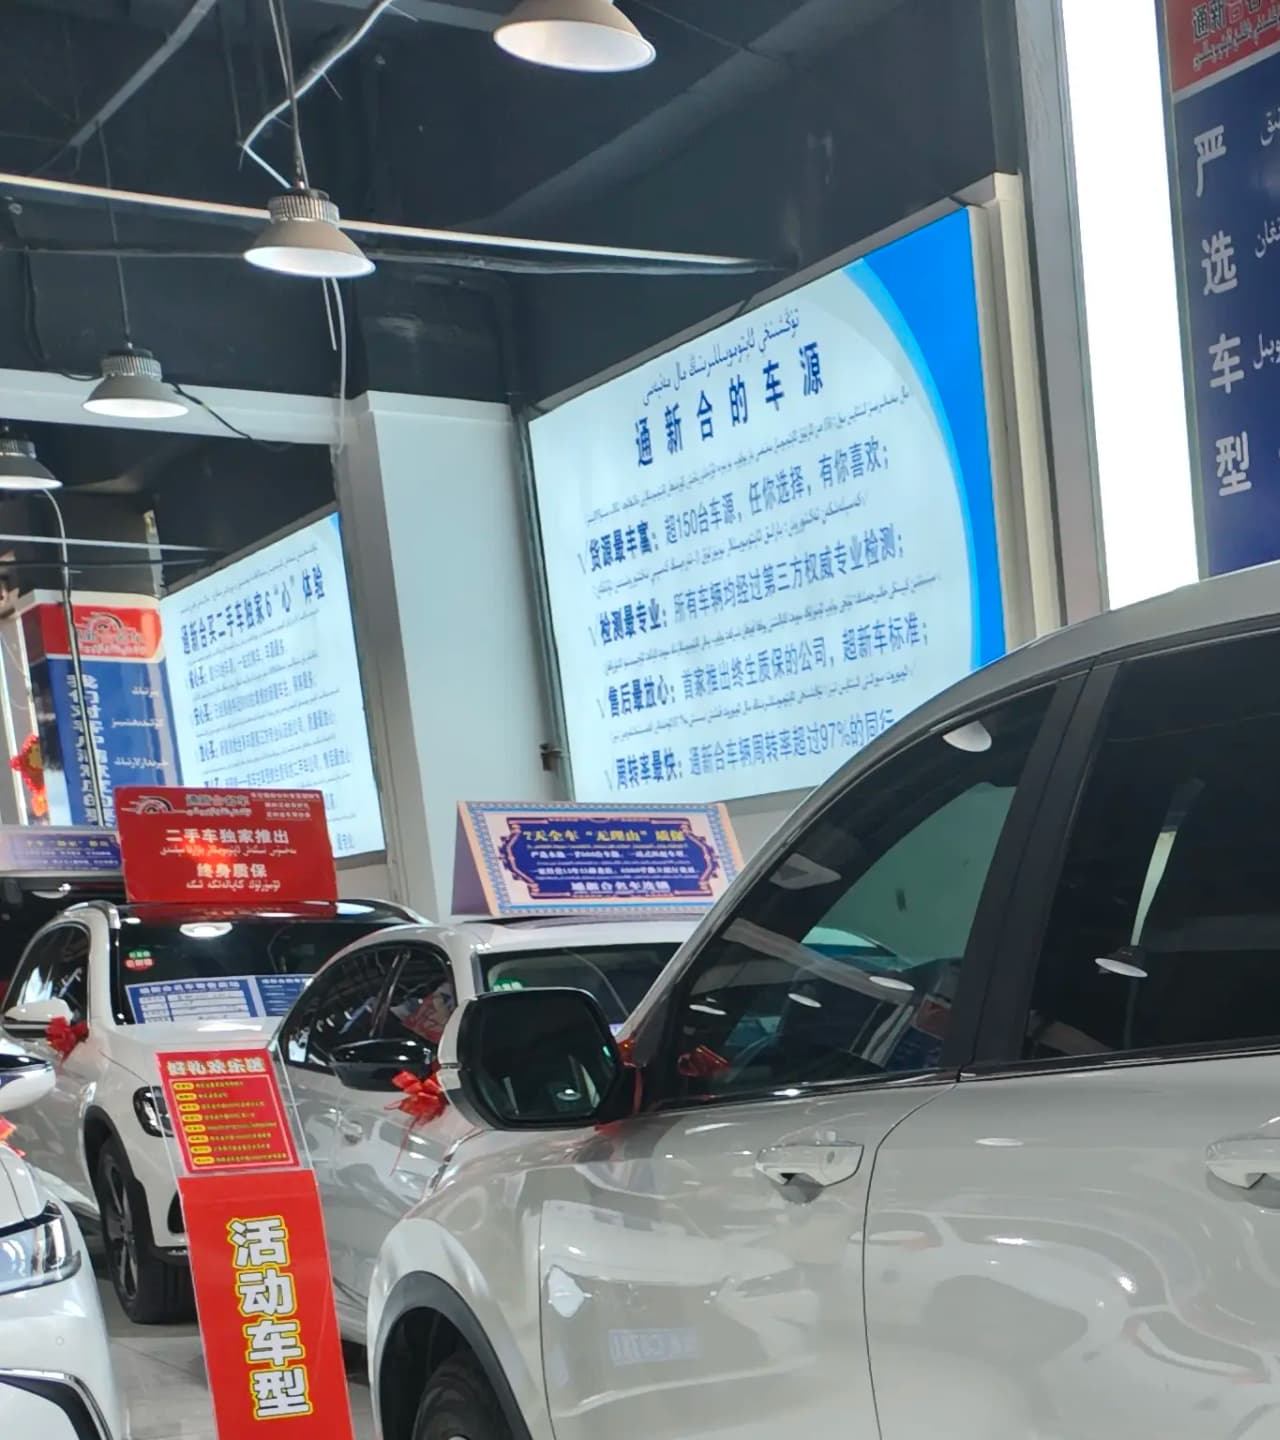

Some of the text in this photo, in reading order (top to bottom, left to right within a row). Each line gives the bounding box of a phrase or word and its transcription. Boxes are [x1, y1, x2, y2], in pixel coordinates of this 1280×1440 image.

[1193, 124, 1252, 497] 严选车型
[633, 341, 824, 467] 通新合的车源
[166, 829, 289, 845] 二手车独家推出
[197, 863, 268, 879] 终身质保
[227, 1215, 313, 1420] 活动车型
